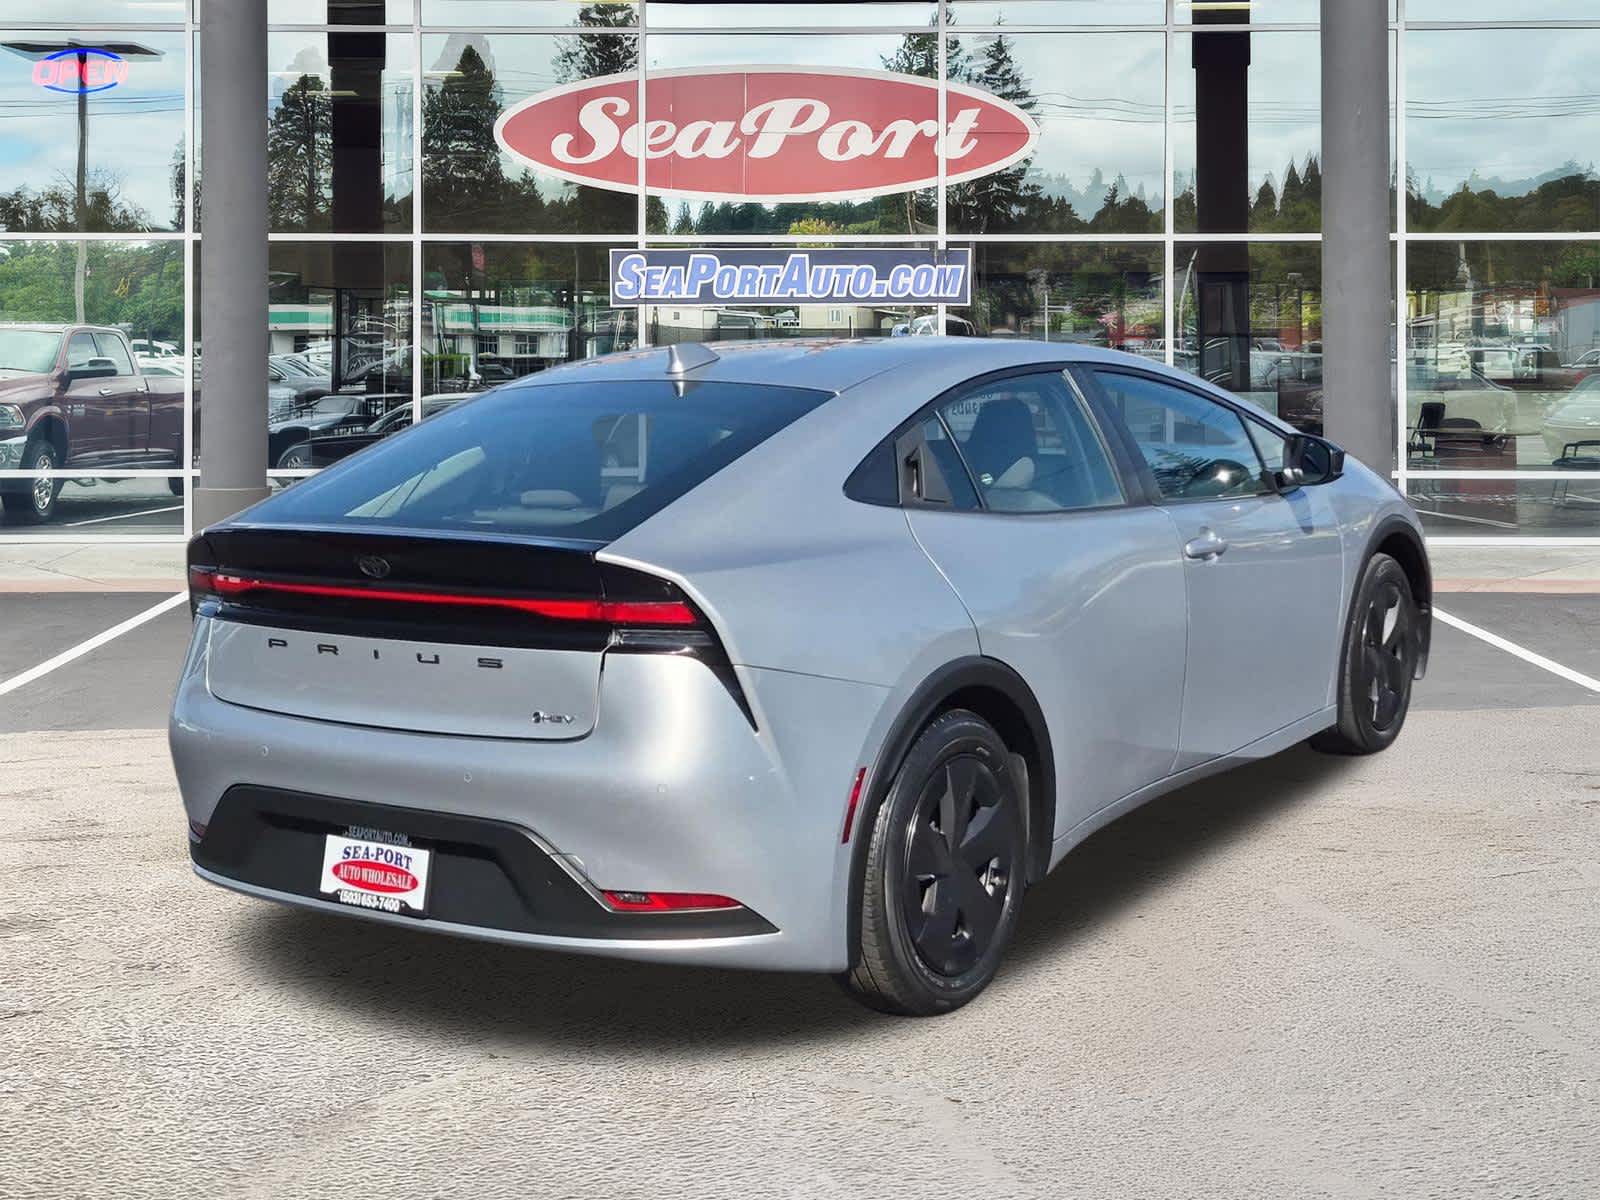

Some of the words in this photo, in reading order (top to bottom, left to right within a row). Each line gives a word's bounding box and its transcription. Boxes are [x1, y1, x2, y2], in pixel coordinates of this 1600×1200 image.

[32, 59, 128, 85] OPEN
[551, 97, 981, 164] SeaPort
[268, 638, 503, 669] PRIUS
[342, 846, 413, 870] SEA-PORT
[338, 863, 361, 881] AUTO
[361, 868, 413, 889] WHOLESALE
[340, 889, 361, 904] (503)
[361, 892, 400, 912] 653-7400
